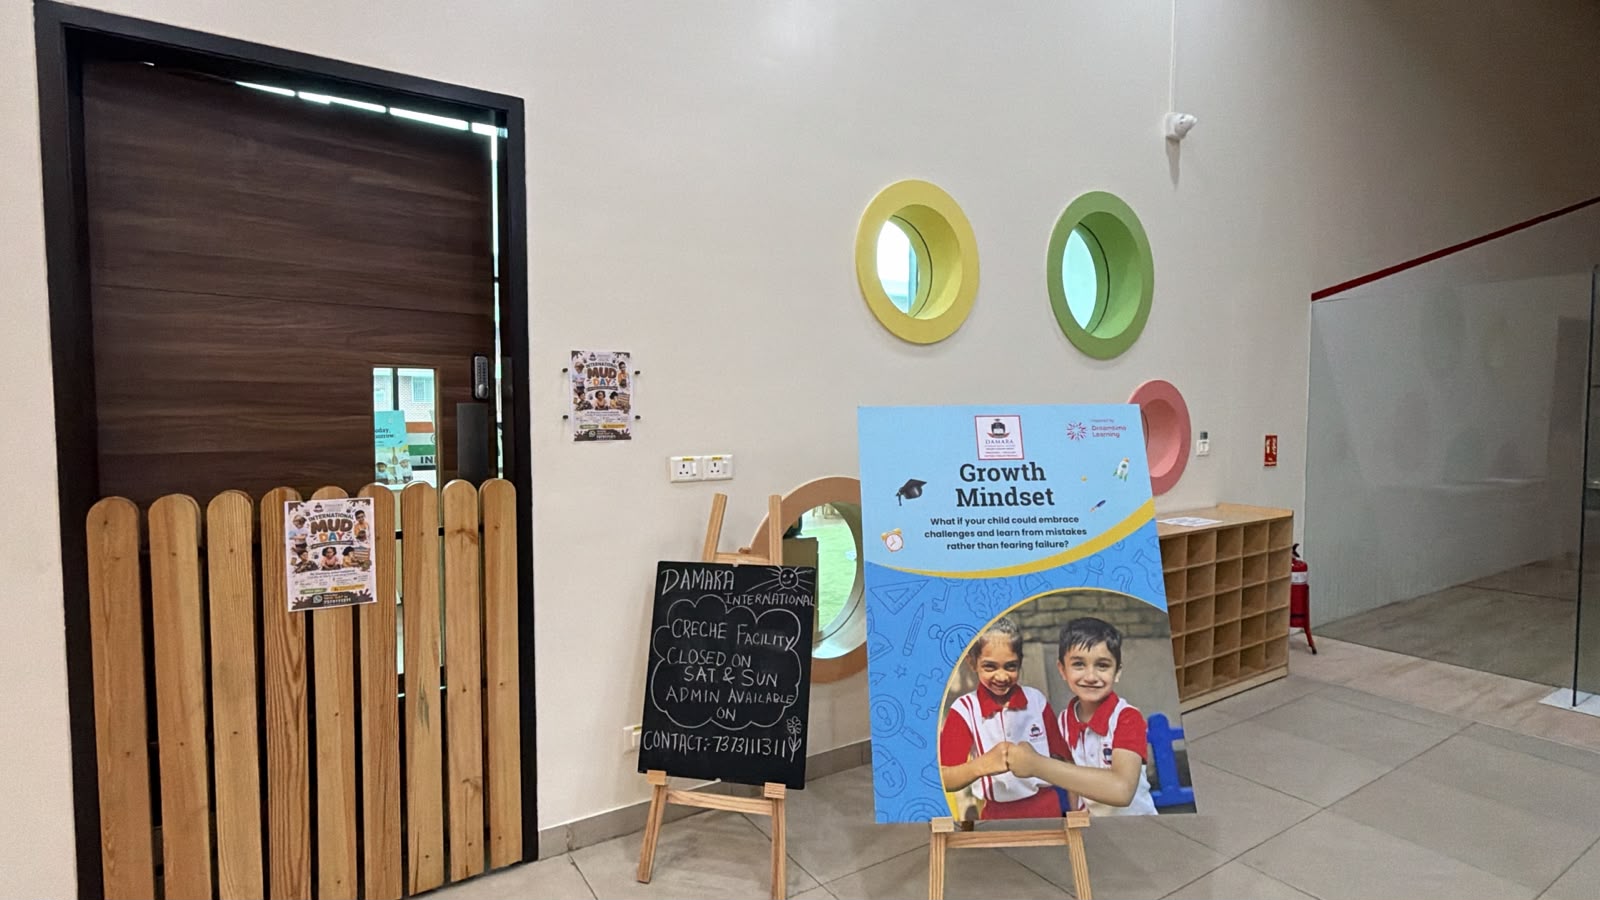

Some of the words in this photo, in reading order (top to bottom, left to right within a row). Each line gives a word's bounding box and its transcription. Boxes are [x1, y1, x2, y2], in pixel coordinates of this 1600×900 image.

[587, 367, 617, 379] MUD
[592, 378, 613, 386] DAY
[959, 461, 1047, 483] Growth
[955, 486, 1055, 507] Mindset
[308, 513, 354, 521] INTERNATIONAL
[930, 517, 955, 525] What
[957, 517, 963, 525] if
[964, 518, 986, 527] your
[987, 516, 1010, 525] child
[1011, 516, 1037, 524] could
[310, 518, 353, 534] MUD
[924, 530, 975, 539] challenges
[976, 529, 995, 537] and
[1021, 528, 1044, 536] from
[319, 532, 345, 542] DAY
[947, 542, 975, 550] rather
[977, 541, 999, 549] than
[1000, 541, 1033, 550] fearing
[1035, 540, 1069, 548] failure?
[661, 568, 735, 596] DAMARA
[724, 592, 815, 607] INTERNATIONAL
[671, 618, 728, 640] CRECHE
[736, 624, 796, 651] FACILITY
[666, 647, 726, 667] CLOSED
[731, 654, 751, 668] ON
[684, 666, 716, 683] SAT
[722, 667, 735, 684] &
[741, 669, 778, 687] SUN
[665, 685, 720, 703] ADMIN
[728, 688, 795, 704] AVAILABLE
[716, 706, 736, 721] ON
